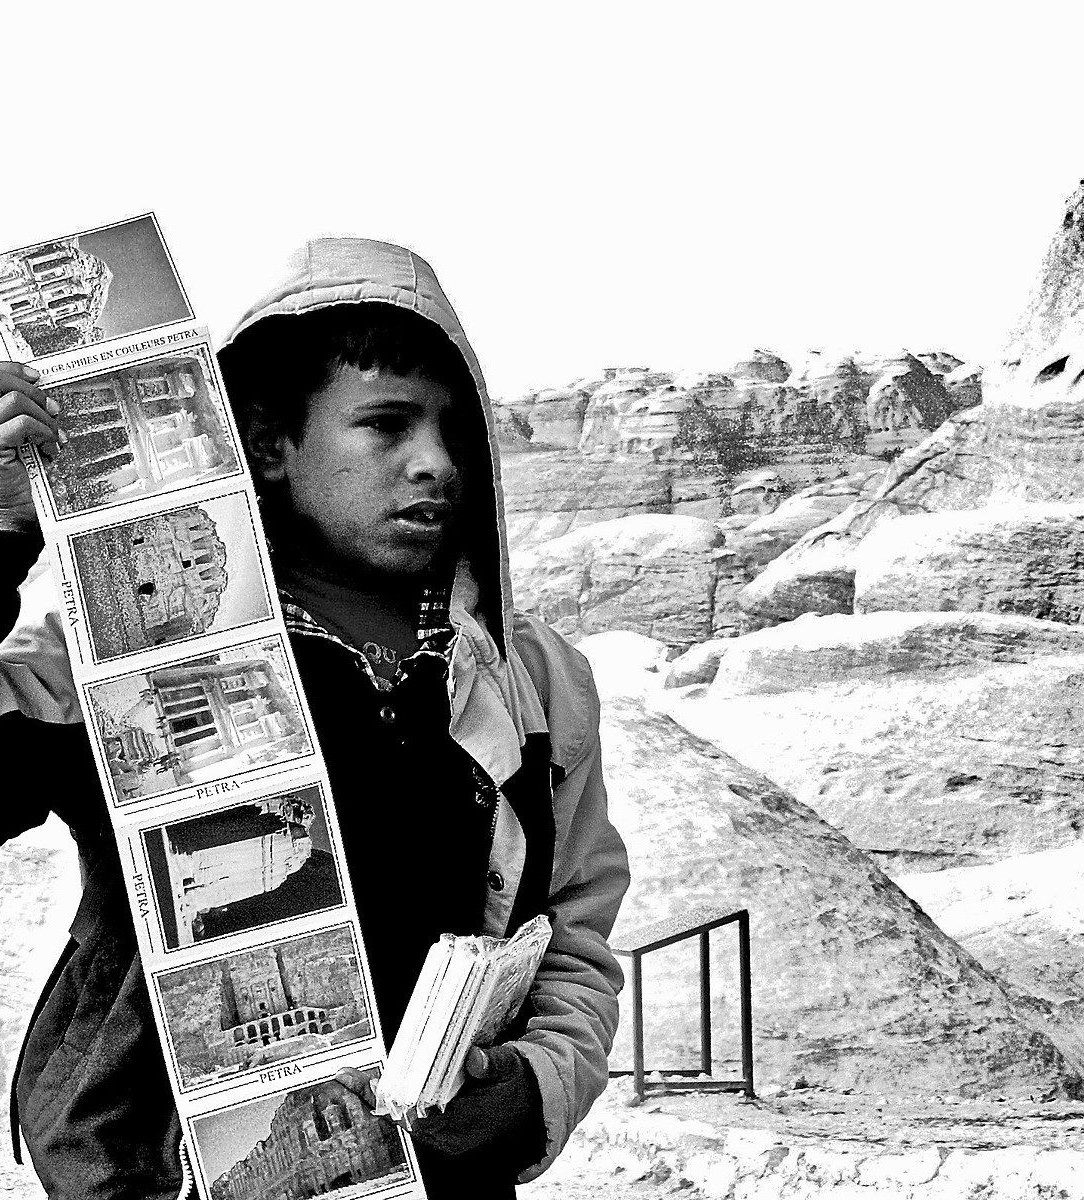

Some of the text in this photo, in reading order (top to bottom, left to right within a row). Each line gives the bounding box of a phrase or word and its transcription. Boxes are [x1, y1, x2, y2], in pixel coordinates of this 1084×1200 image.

[50, 354, 99, 374] GRAPHIES
[100, 350, 115, 362] EN
[115, 336, 167, 357] COULEURS
[167, 328, 199, 345] PETRA
[61, 581, 80, 627] PETRA
[196, 780, 241, 800] PETRA
[132, 873, 150, 918] PETRA
[259, 1063, 302, 1084] PETRA
